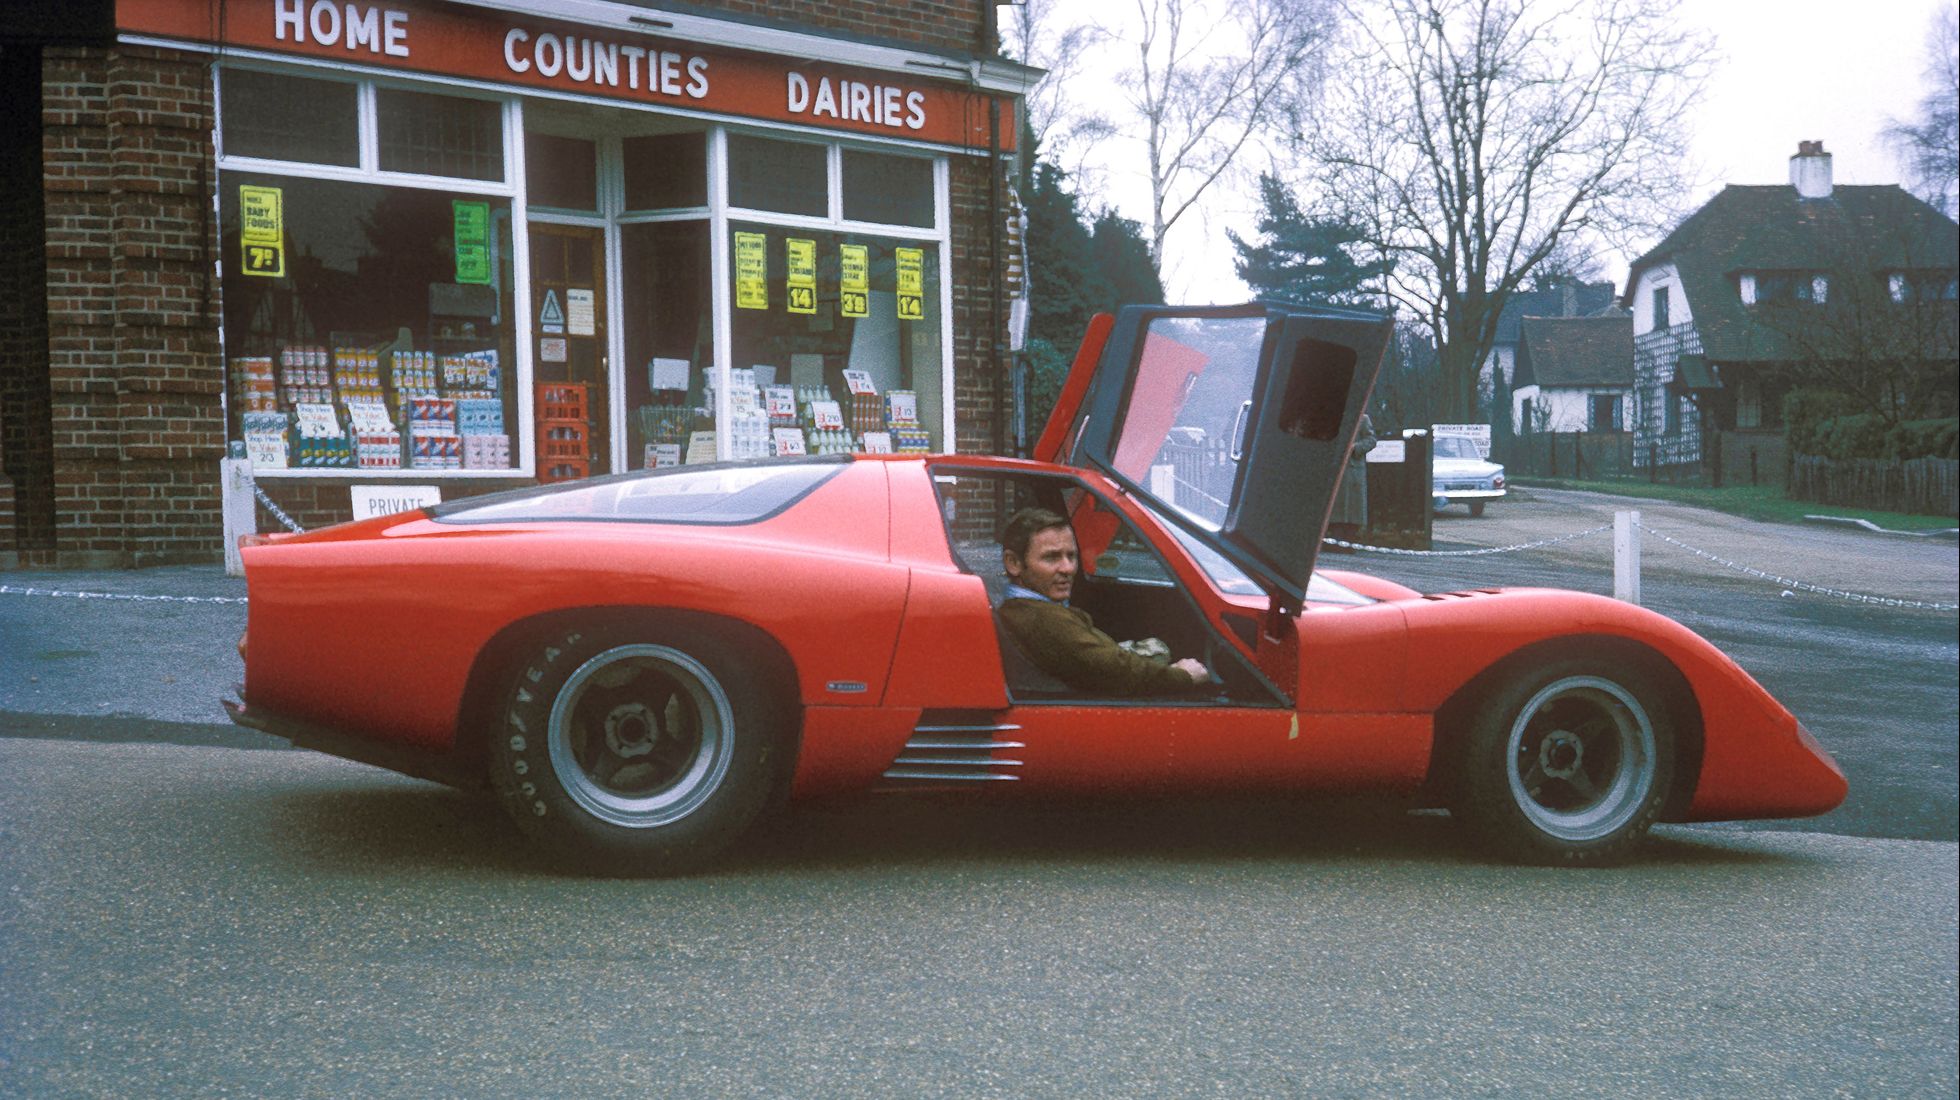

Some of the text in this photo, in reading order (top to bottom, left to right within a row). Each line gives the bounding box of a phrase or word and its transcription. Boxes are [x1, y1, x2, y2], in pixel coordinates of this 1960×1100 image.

[275, 0, 926, 130] HOME COUNTIES DAIRIES
[247, 207, 270, 217] BABY
[247, 218, 275, 229] FOODS
[369, 498, 424, 516] PRIVATE
